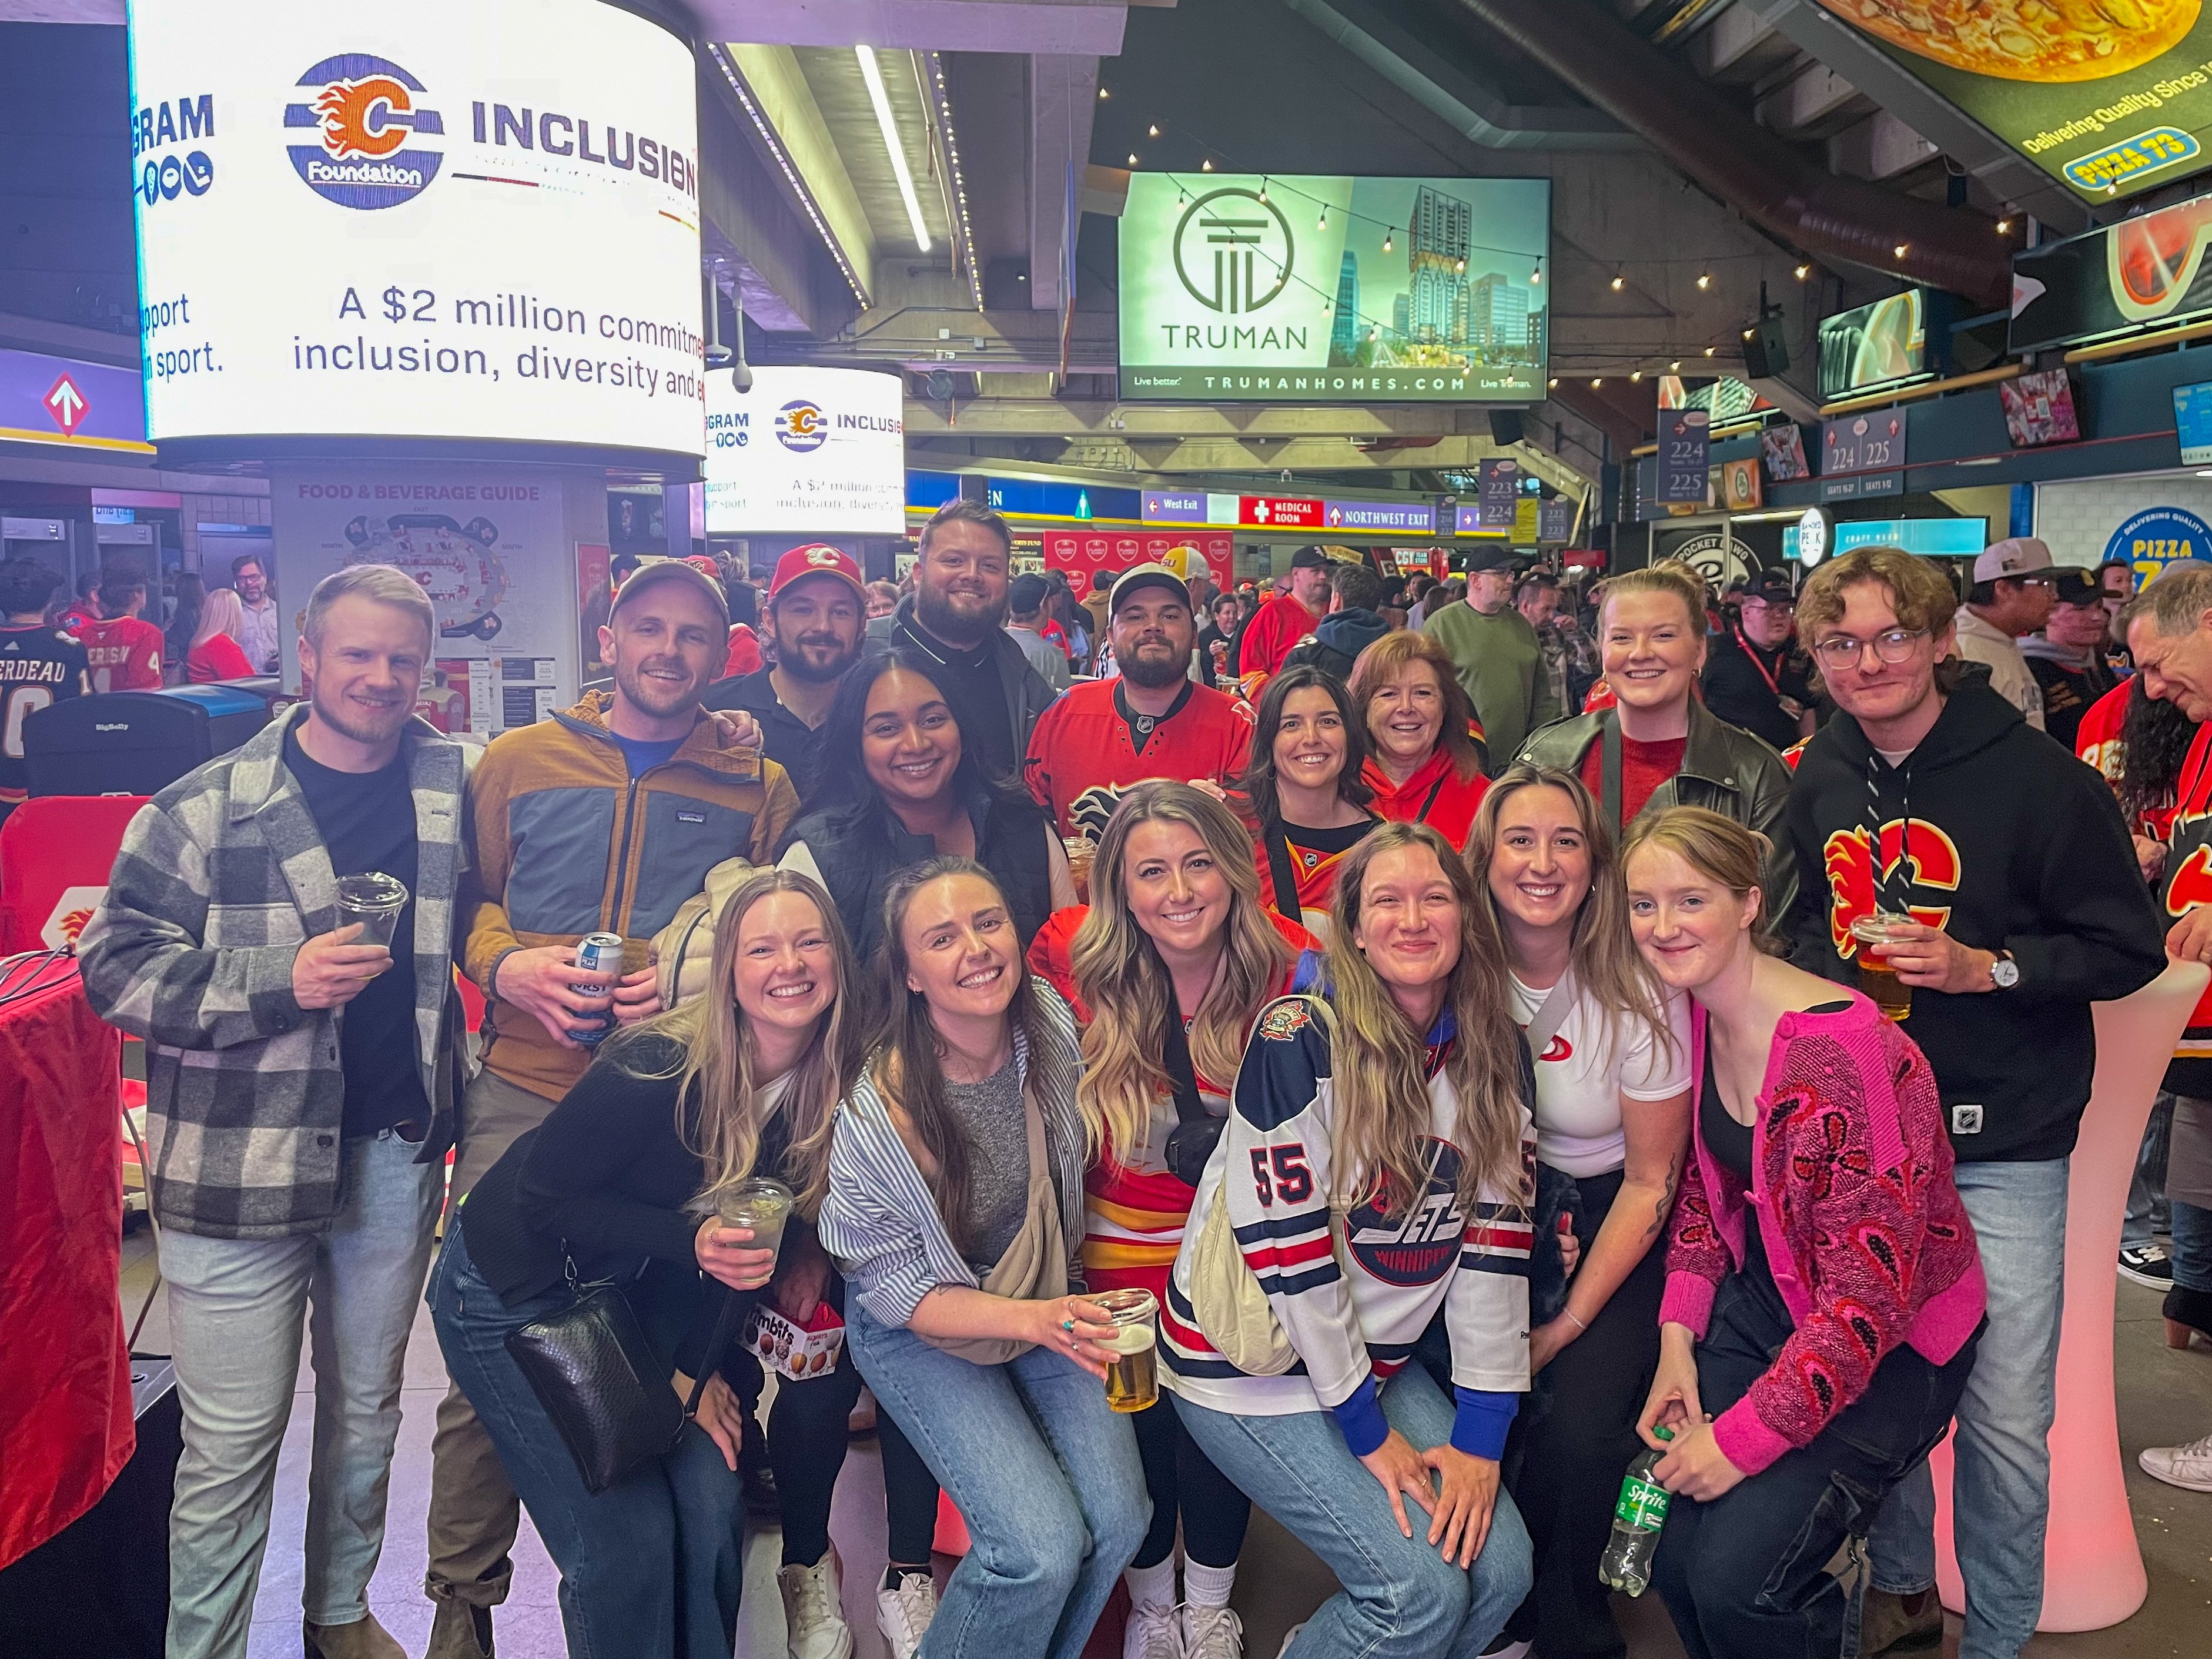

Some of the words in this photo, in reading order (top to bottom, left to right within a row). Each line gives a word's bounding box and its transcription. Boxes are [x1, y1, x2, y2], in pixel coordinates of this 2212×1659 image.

[2022, 115, 2106, 154] Delivering
[2094, 91, 2163, 123] Quality
[2153, 71, 2208, 98] Since
[2074, 147, 2151, 185] PIZZA
[2140, 133, 2186, 159] 73
[307, 159, 423, 187] Foundation
[338, 286, 366, 320] A
[382, 285, 437, 325] $2
[455, 293, 587, 336] million
[1161, 325, 1307, 350] TRUMAN
[156, 342, 223, 383] sport.
[294, 334, 502, 384] inclusion,
[517, 343, 659, 398] diversity
[666, 369, 695, 399] and
[1134, 376, 1152, 386] Live
[1204, 376, 1464, 390] TRUMANHOMES.COM
[1480, 379, 1498, 389] Live
[1670, 441, 1704, 459] 224
[1832, 446, 1855, 470] 224
[1866, 440, 1890, 466] 225
[793, 480, 802, 490] A
[831, 480, 872, 492] million
[1488, 482, 1512, 495] 223
[1669, 473, 1702, 490] 225
[297, 484, 353, 499] FOOD
[358, 484, 372, 500] &
[374, 485, 477, 500] BEVERAGE
[480, 486, 540, 501] GUIDE
[1163, 499, 1182, 510] West
[1183, 500, 1197, 510] Exit
[1274, 502, 1312, 513] MEDICAL
[1487, 506, 1512, 518] 224
[1275, 513, 1300, 523] ROOM
[1345, 510, 1405, 525] NORTHWEST
[1408, 513, 1430, 526] EXIT
[2123, 512, 2170, 537] DELIVERING
[2172, 513, 2204, 535] QUALITY
[1395, 550, 1414, 565] CGY
[1677, 538, 1718, 563] POCKET
[2132, 539, 2193, 558] PIZZA
[2133, 560, 2176, 594] 7
[148, 651, 160, 675] 4
[581, 958, 596, 967] PEAK
[1249, 1142, 1314, 1208] 55
[1350, 1183, 1467, 1244] JETS
[807, 1332, 829, 1342] ALWAYS
[1628, 1484, 1667, 1510] Sprite
